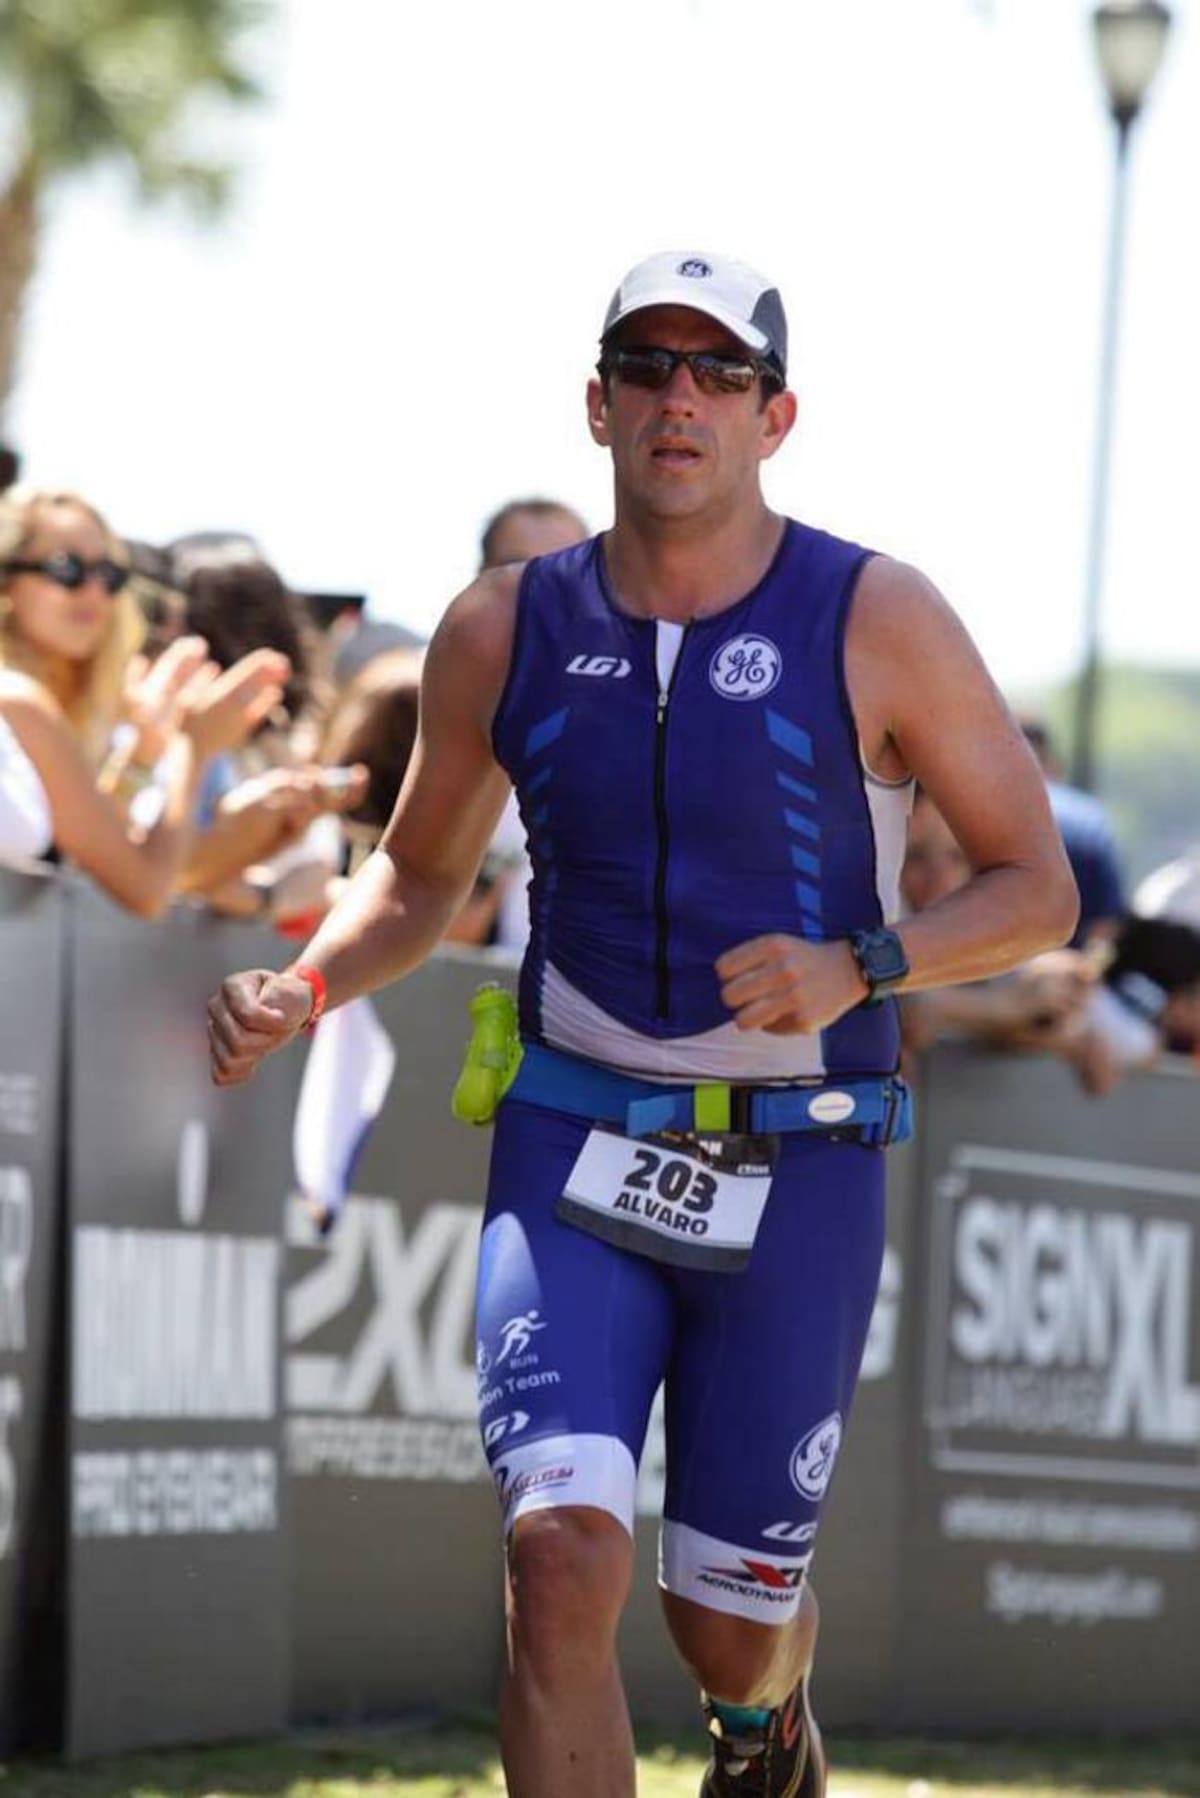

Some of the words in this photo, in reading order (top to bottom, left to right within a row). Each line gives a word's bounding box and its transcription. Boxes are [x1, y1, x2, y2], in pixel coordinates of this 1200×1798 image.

[624, 1149, 719, 1213] 203
[613, 1191, 709, 1236] ALVARO
[510, 1353, 539, 1369] RUN
[505, 1371, 561, 1394] Team
